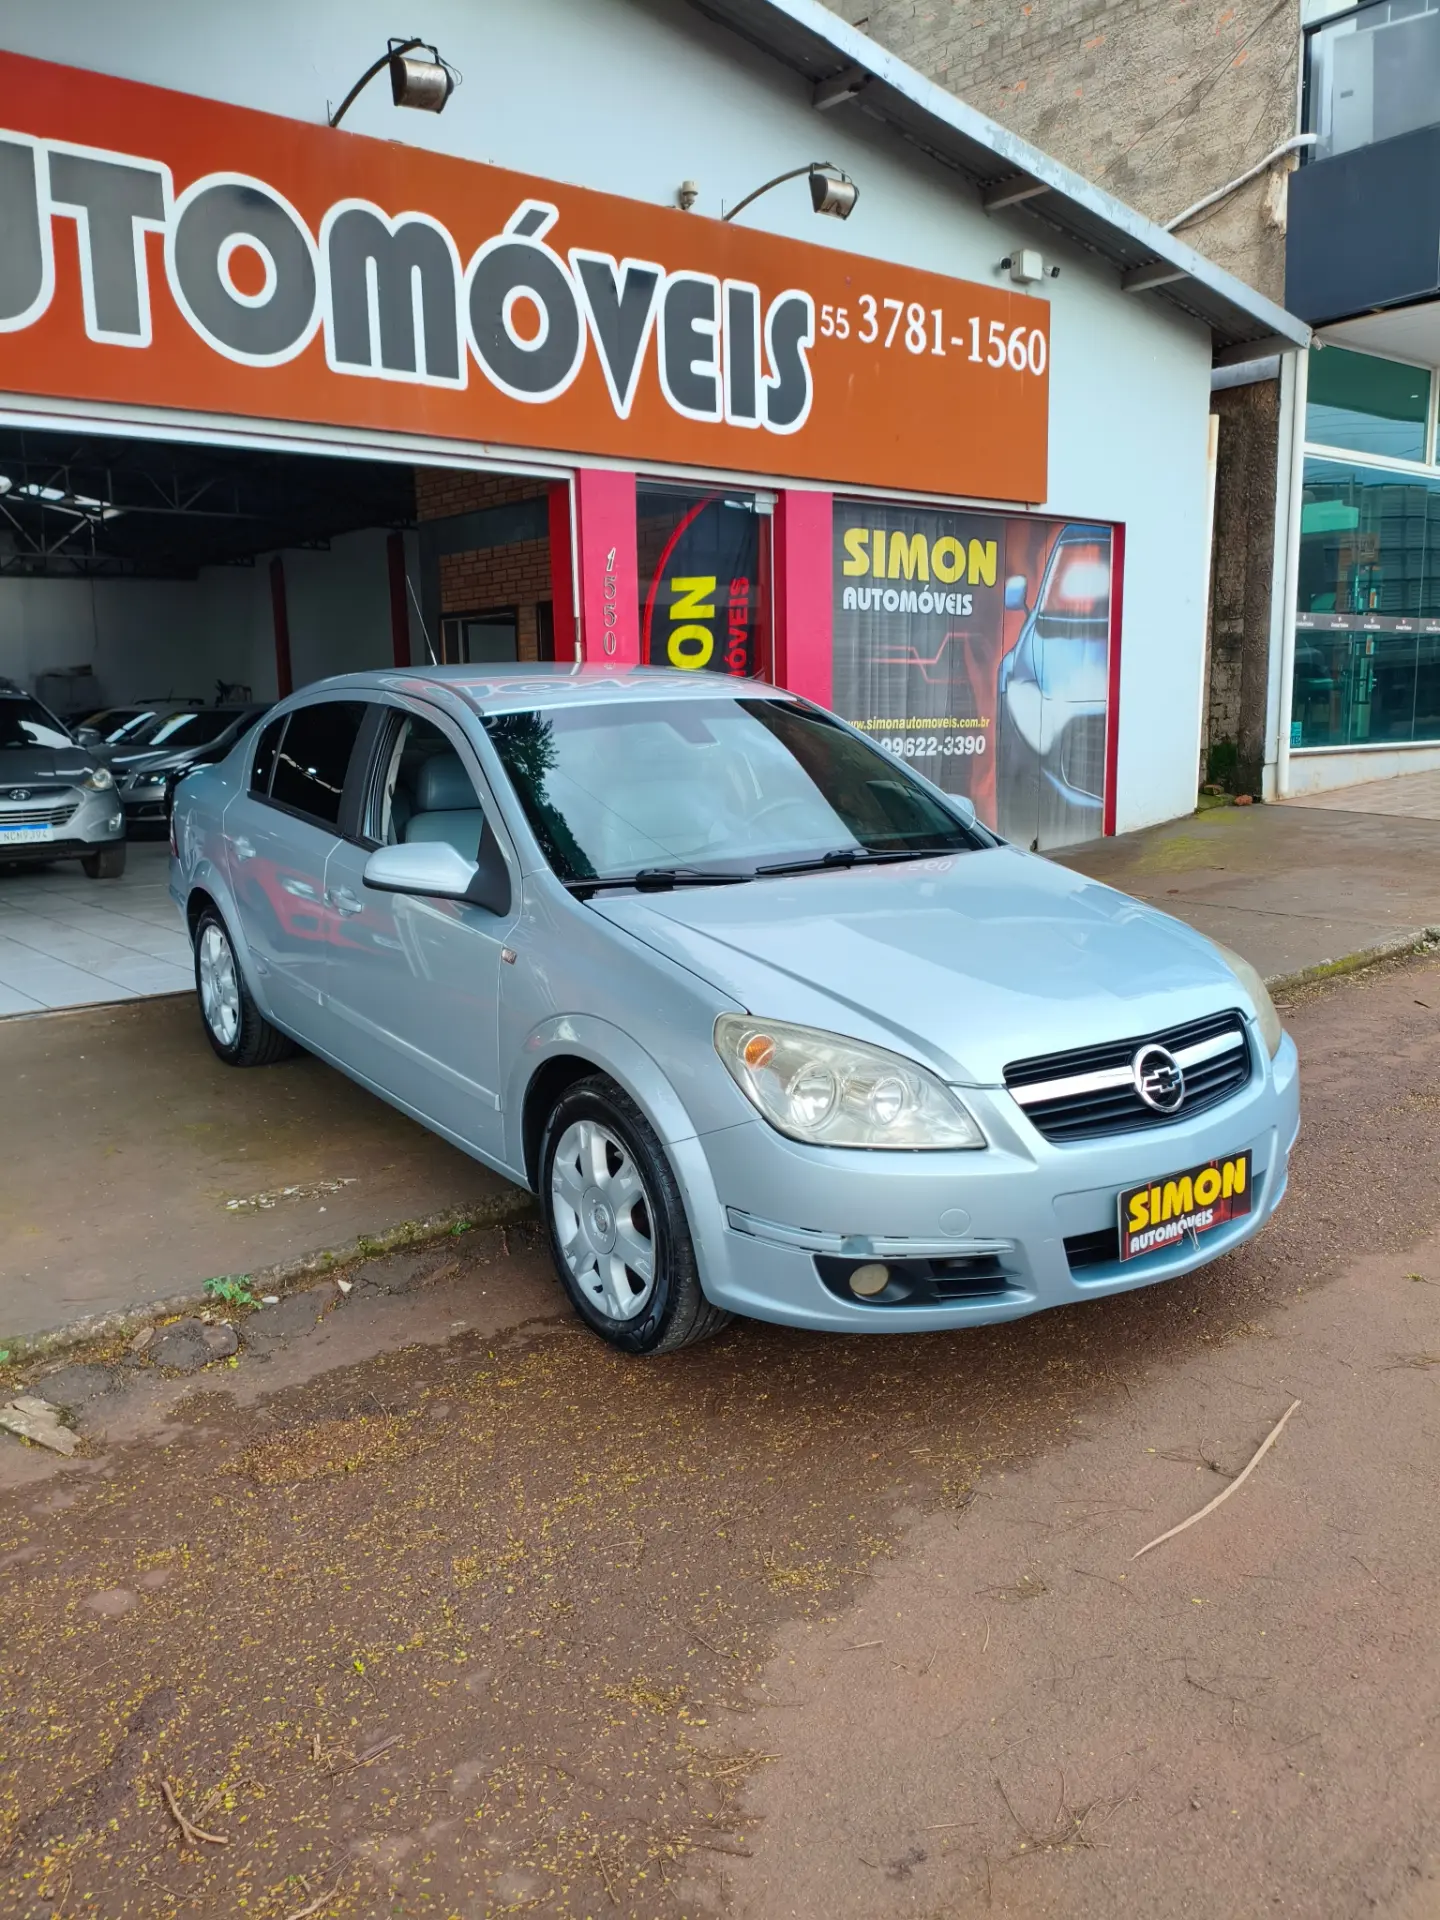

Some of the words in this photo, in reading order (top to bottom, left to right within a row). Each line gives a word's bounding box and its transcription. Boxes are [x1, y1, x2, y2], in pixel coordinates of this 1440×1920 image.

[820, 304, 850, 340] 55
[858, 294, 1047, 376] 3781-1560
[843, 527, 998, 587] SIMON
[603, 547, 617, 655] 1550
[724, 576, 750, 677] ÓVEIS
[842, 584, 973, 616] AUTOMÓVEIS
[847, 715, 990, 730] ww.simonautomoveis.com.br
[1129, 1157, 1246, 1233] SIMON
